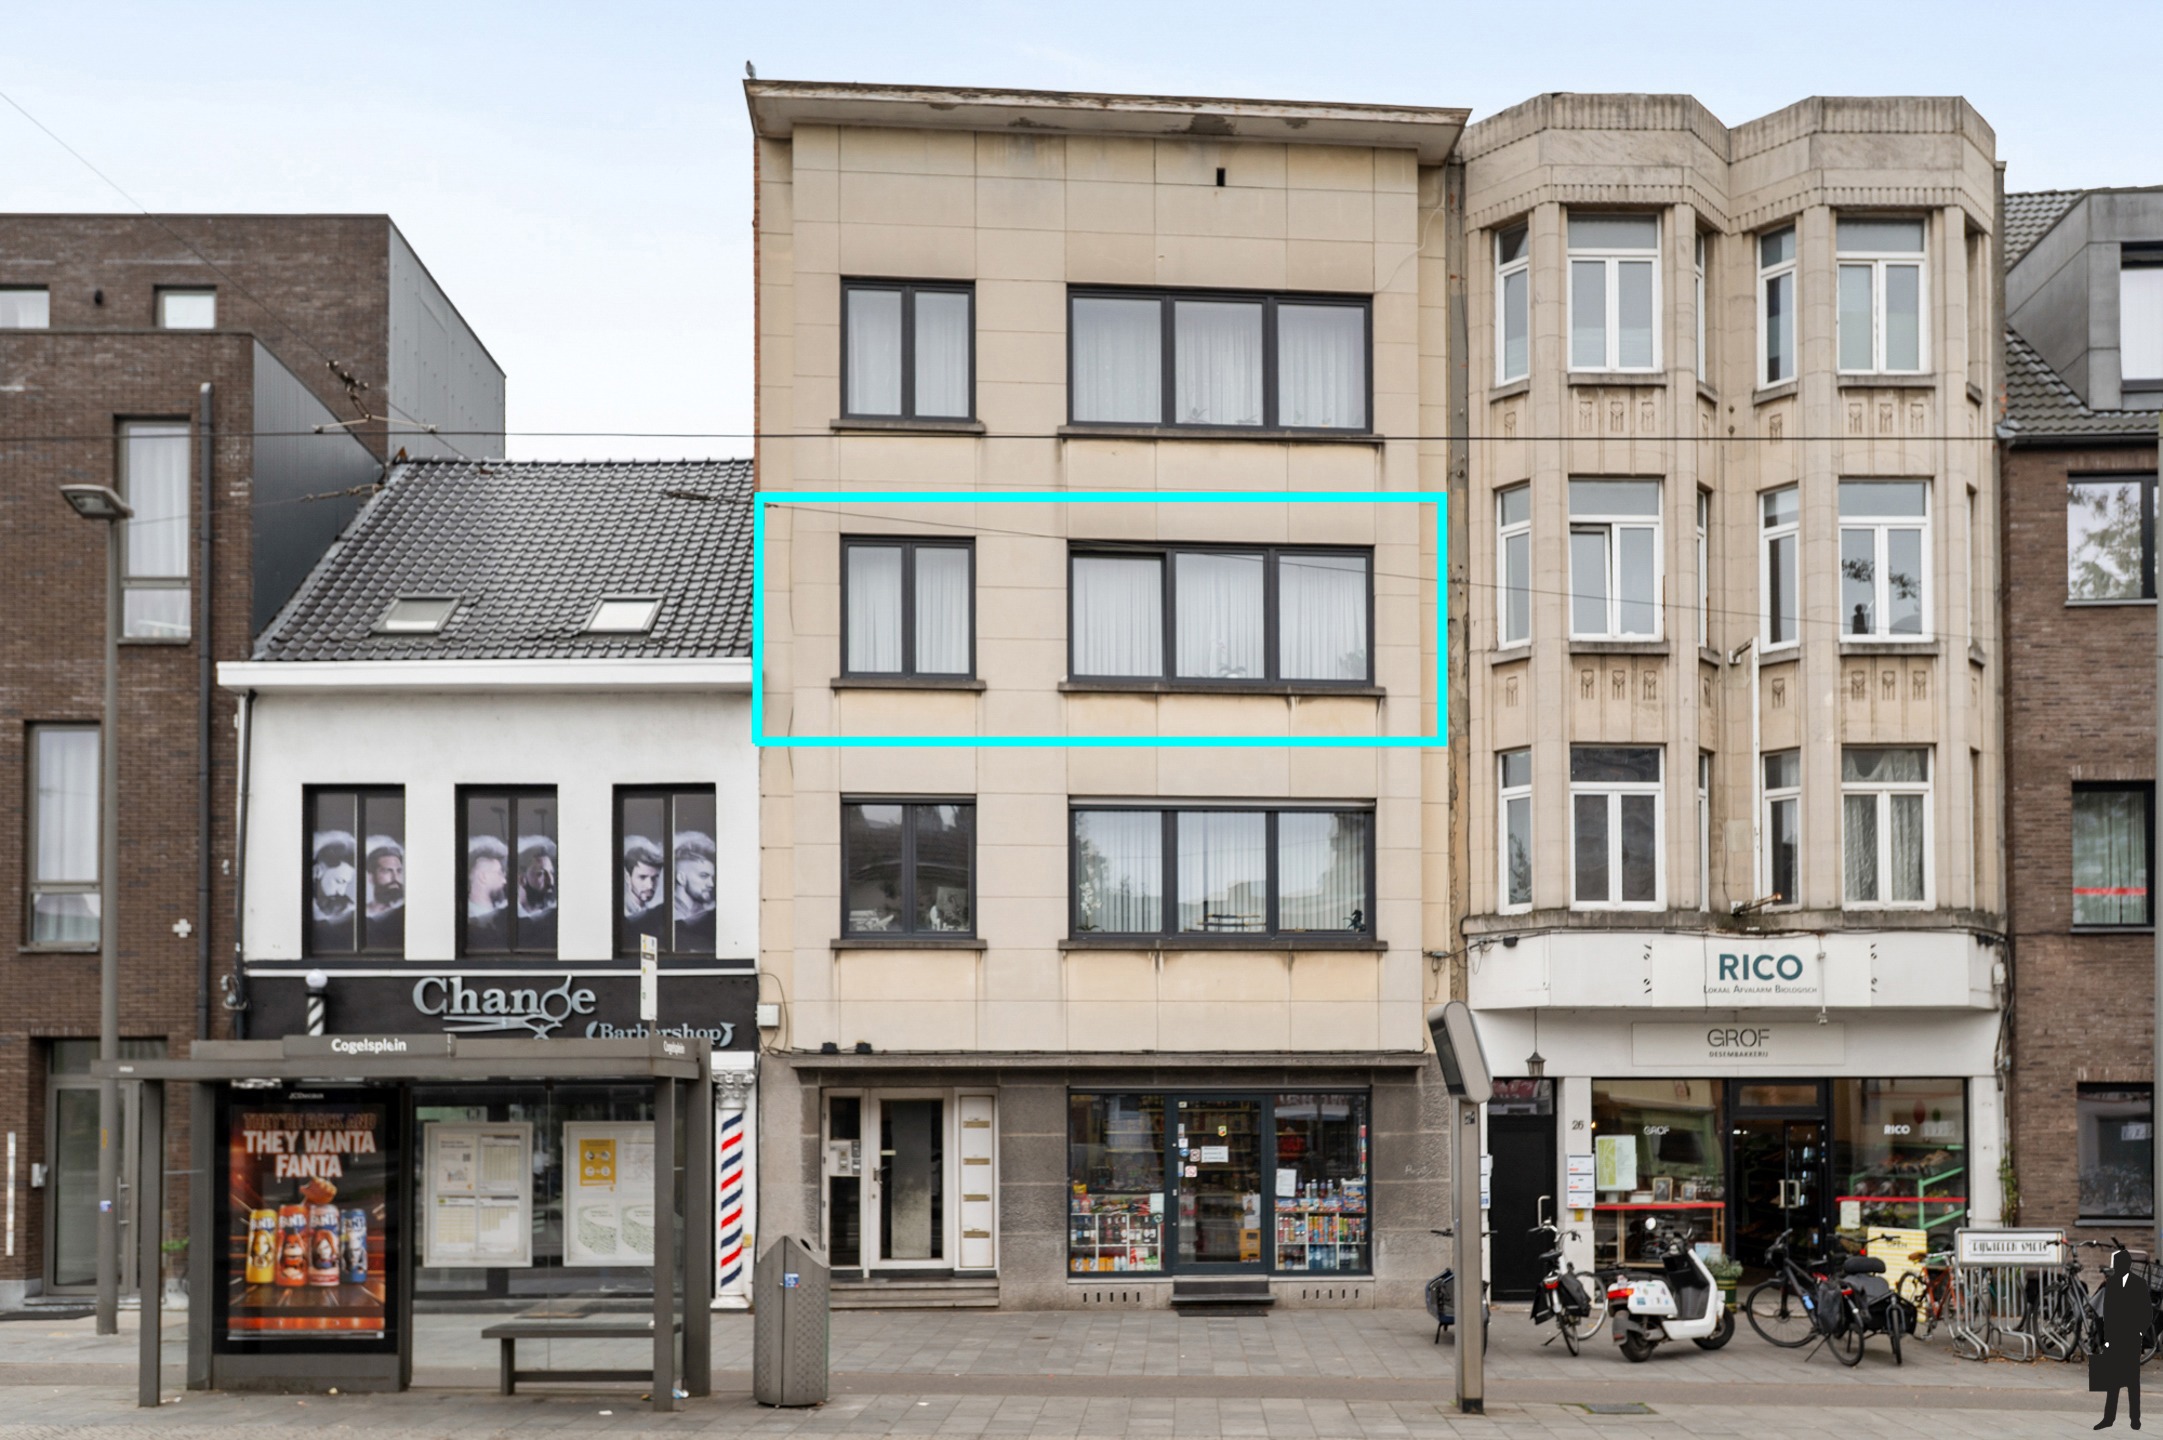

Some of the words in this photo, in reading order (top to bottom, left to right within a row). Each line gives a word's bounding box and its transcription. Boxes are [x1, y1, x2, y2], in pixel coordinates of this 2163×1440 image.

[1719, 953, 1804, 981] RICO
[331, 1038, 407, 1055] Cogelsplein
[1707, 1028, 1770, 1048] GROF
[1572, 1120, 1584, 1130] 26
[1643, 1125, 1670, 1136] GROF
[1883, 1124, 1911, 1135] RICO
[243, 1130, 299, 1154] THEY
[304, 1130, 377, 1154] WANTA
[276, 1154, 343, 1178] FANTA
